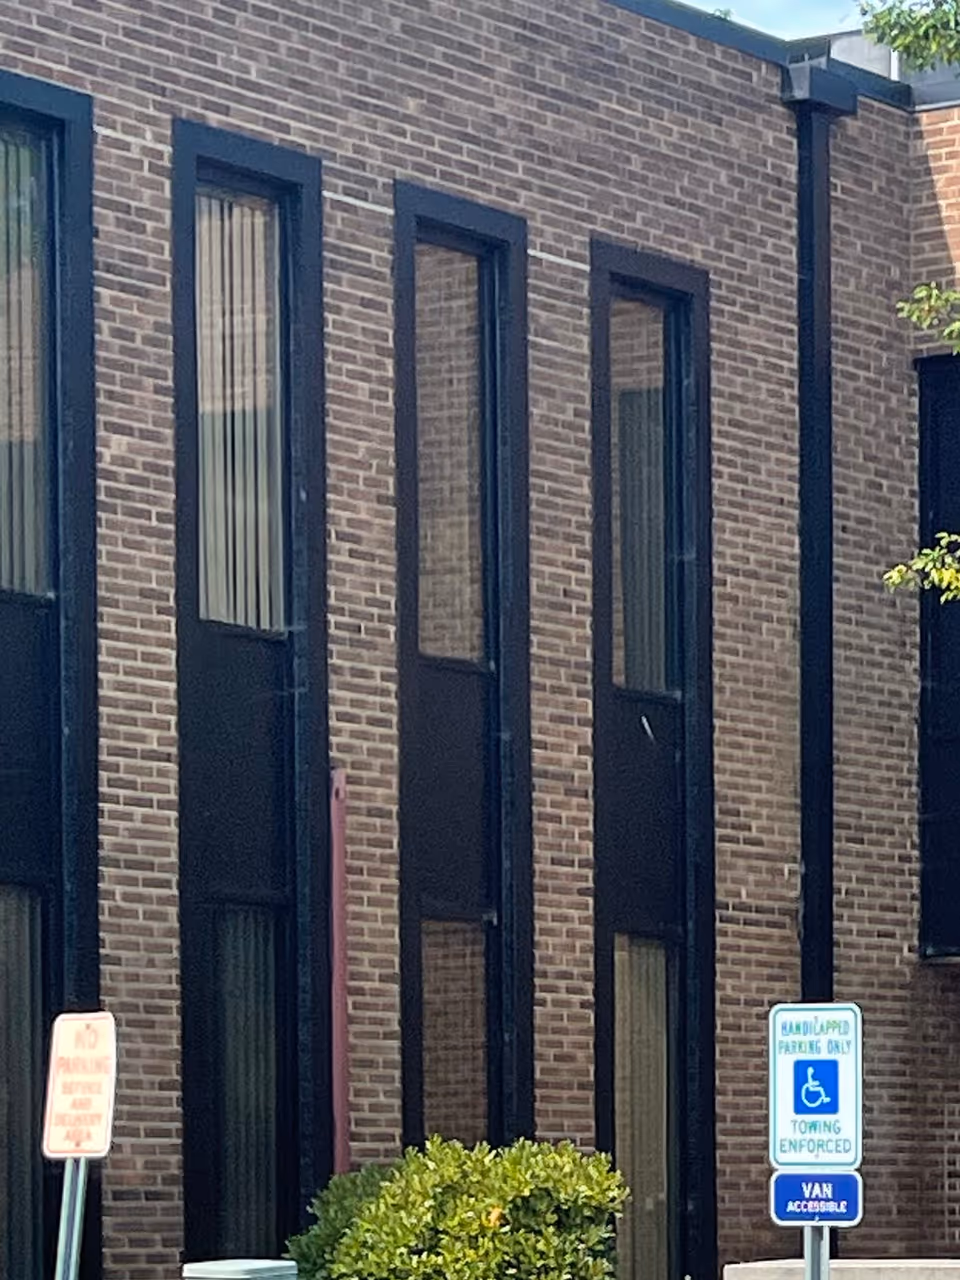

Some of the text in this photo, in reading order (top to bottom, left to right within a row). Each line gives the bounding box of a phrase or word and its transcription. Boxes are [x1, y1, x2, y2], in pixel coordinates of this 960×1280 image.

[781, 1020, 850, 1037] HANDICAPPED
[778, 1039, 852, 1055] PARKING ONLY
[791, 1119, 842, 1135] TOWING
[779, 1138, 852, 1154] ENFORCED
[801, 1182, 834, 1198] VAN
[786, 1200, 848, 1213] ACCESSIBLE
